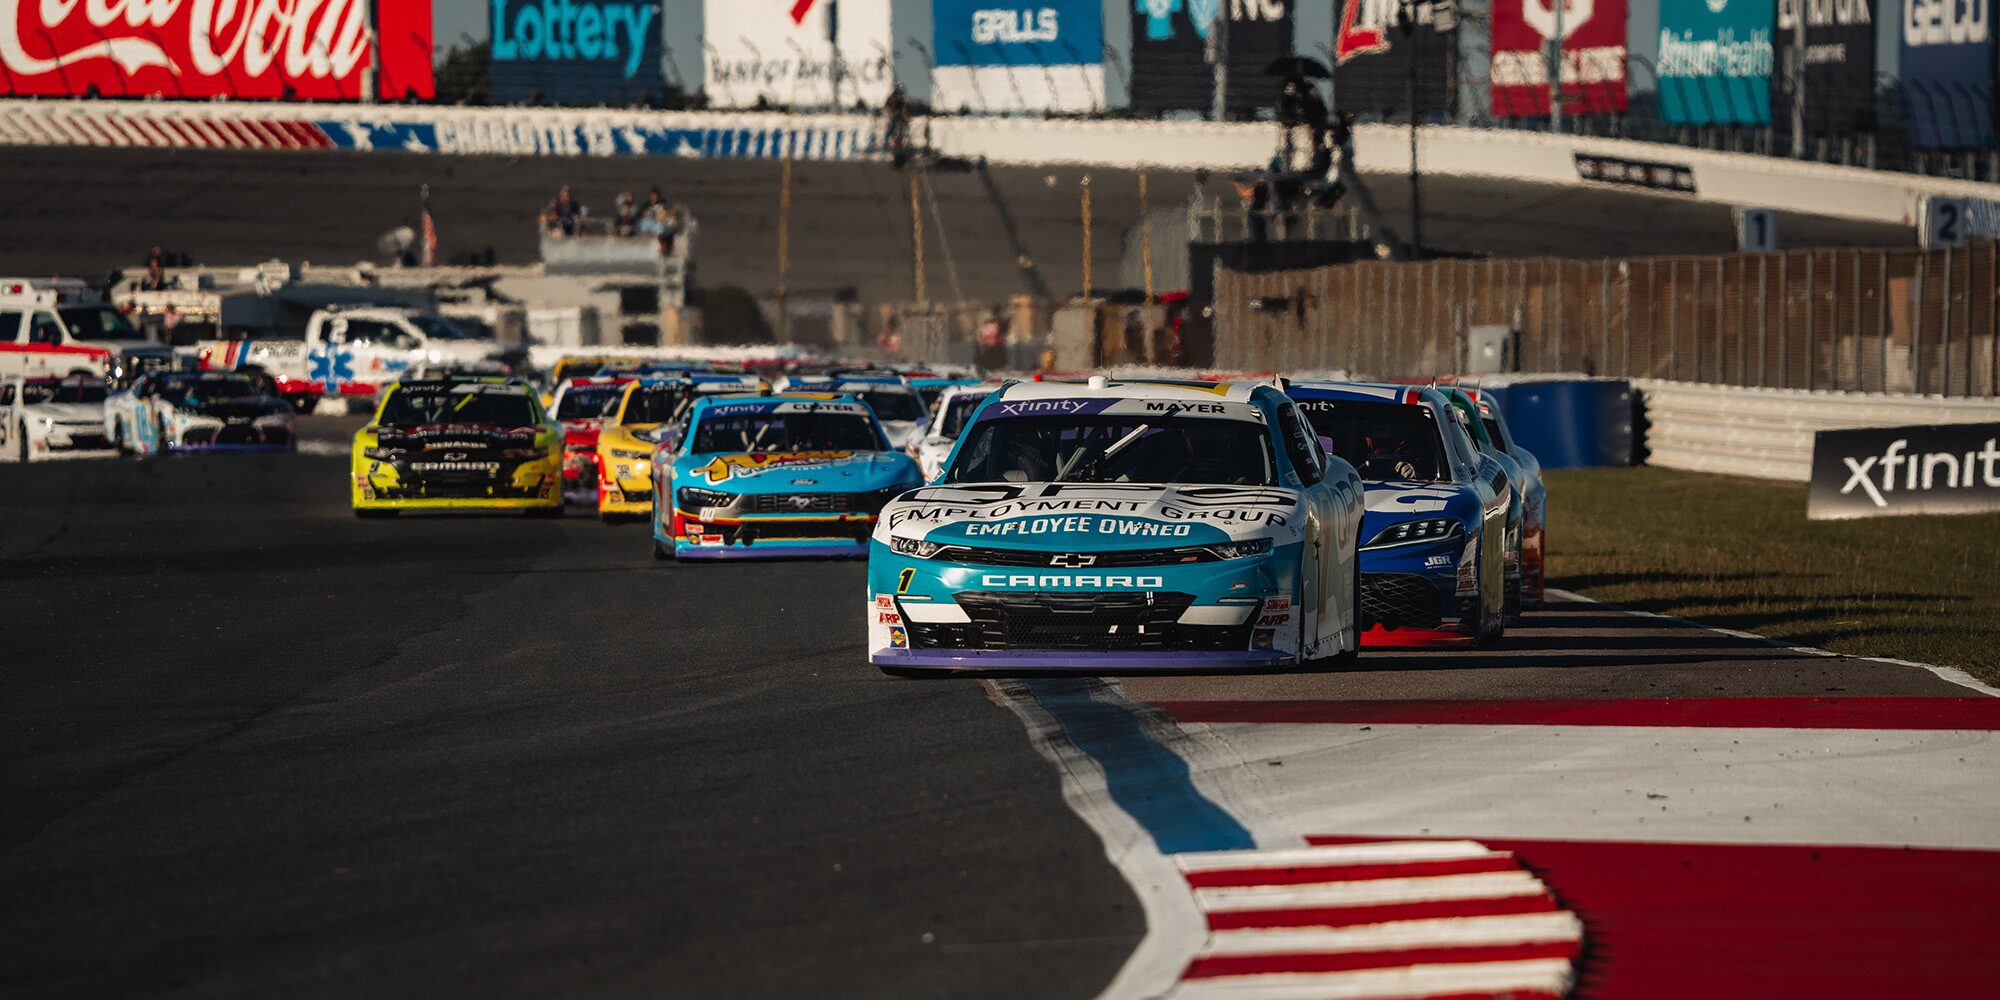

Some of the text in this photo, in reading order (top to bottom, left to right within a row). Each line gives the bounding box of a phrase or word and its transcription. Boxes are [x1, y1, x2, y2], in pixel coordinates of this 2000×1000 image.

[971, 9, 1058, 43] GRILLS
[1903, 0, 1988, 46] GEICO
[491, 0, 655, 78] Lottery
[1754, 214, 1768, 248] 1
[1938, 203, 1958, 241] 2
[714, 403, 764, 416] xfinity
[793, 403, 854, 413] CUSTER
[1000, 400, 1089, 416] xfinity
[1146, 402, 1226, 414] MAYER
[889, 499, 1287, 531] EMPLOYMENT GROUP
[966, 516, 1191, 537] EMPLOYEE OWNED
[1424, 556, 1452, 567] JGR
[897, 567, 917, 595] 1
[982, 574, 1163, 588] CAMARO
[879, 612, 900, 624] ARP
[1256, 613, 1290, 626] ARP
